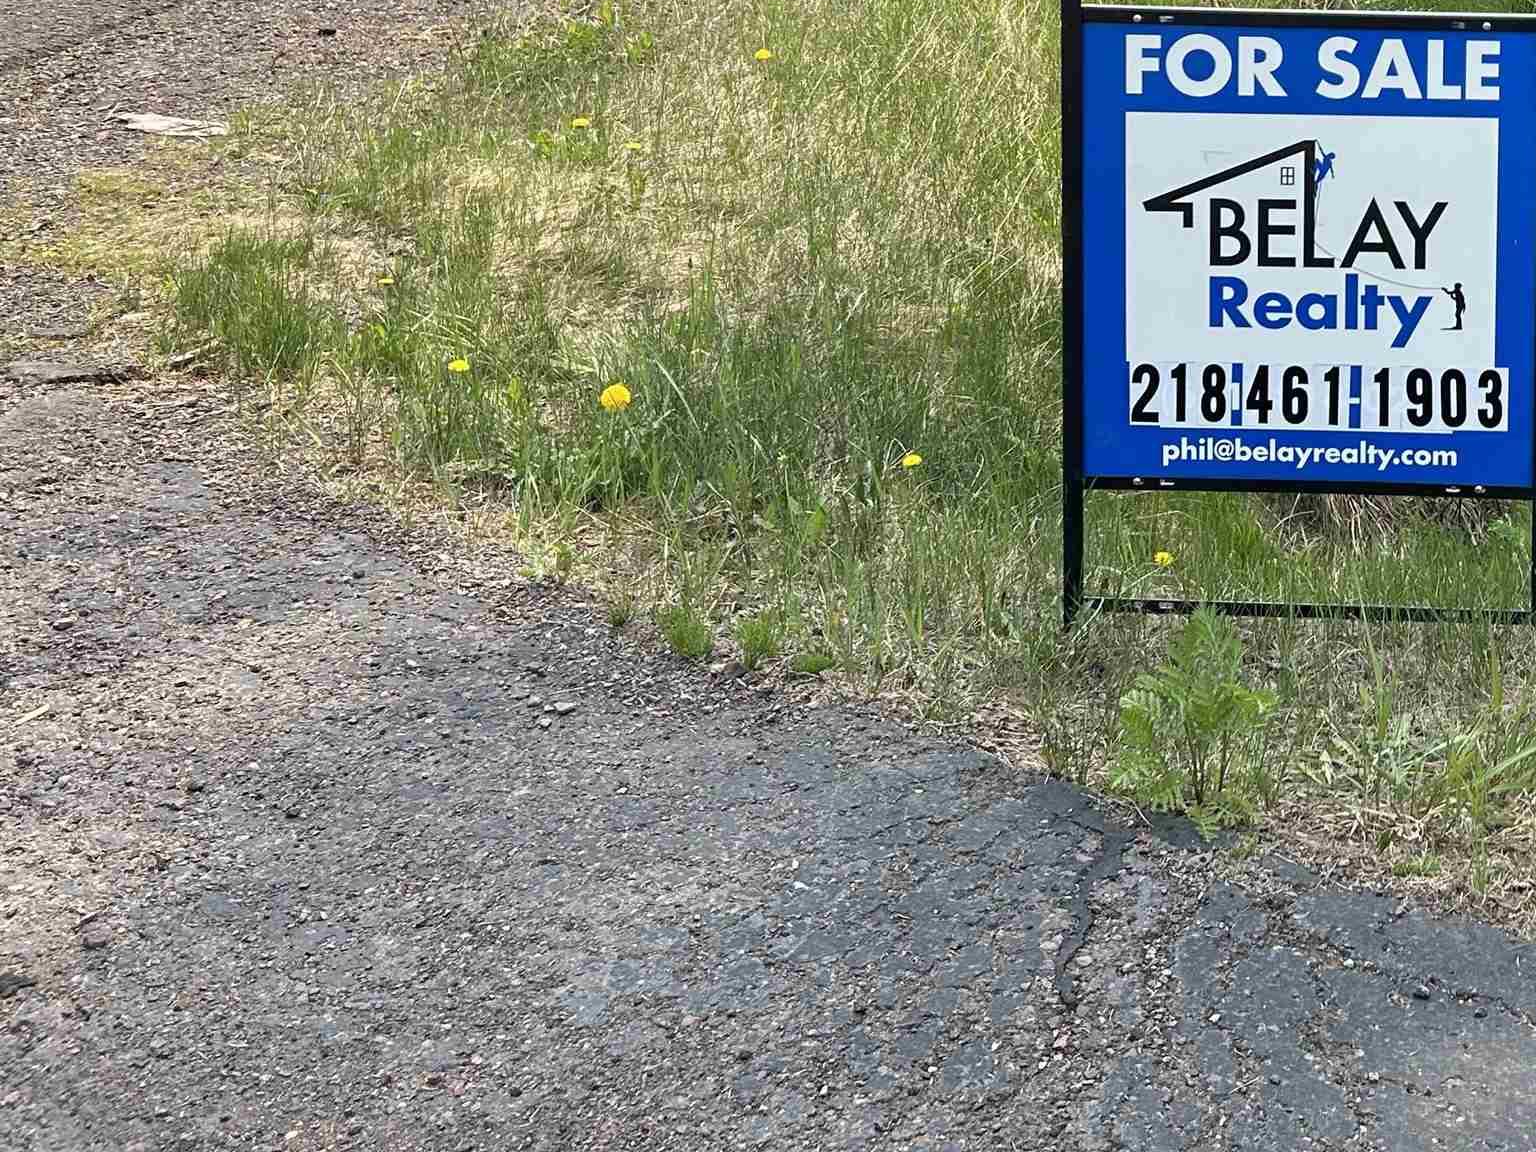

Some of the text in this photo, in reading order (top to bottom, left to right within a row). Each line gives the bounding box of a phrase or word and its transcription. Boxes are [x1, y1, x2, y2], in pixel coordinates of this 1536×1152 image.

[1125, 33, 1500, 101] FOR SALE
[1208, 194, 1448, 270] BELAY
[1208, 274, 1432, 348] Realty
[1162, 437, 1458, 470] phil@belayrealty.com
